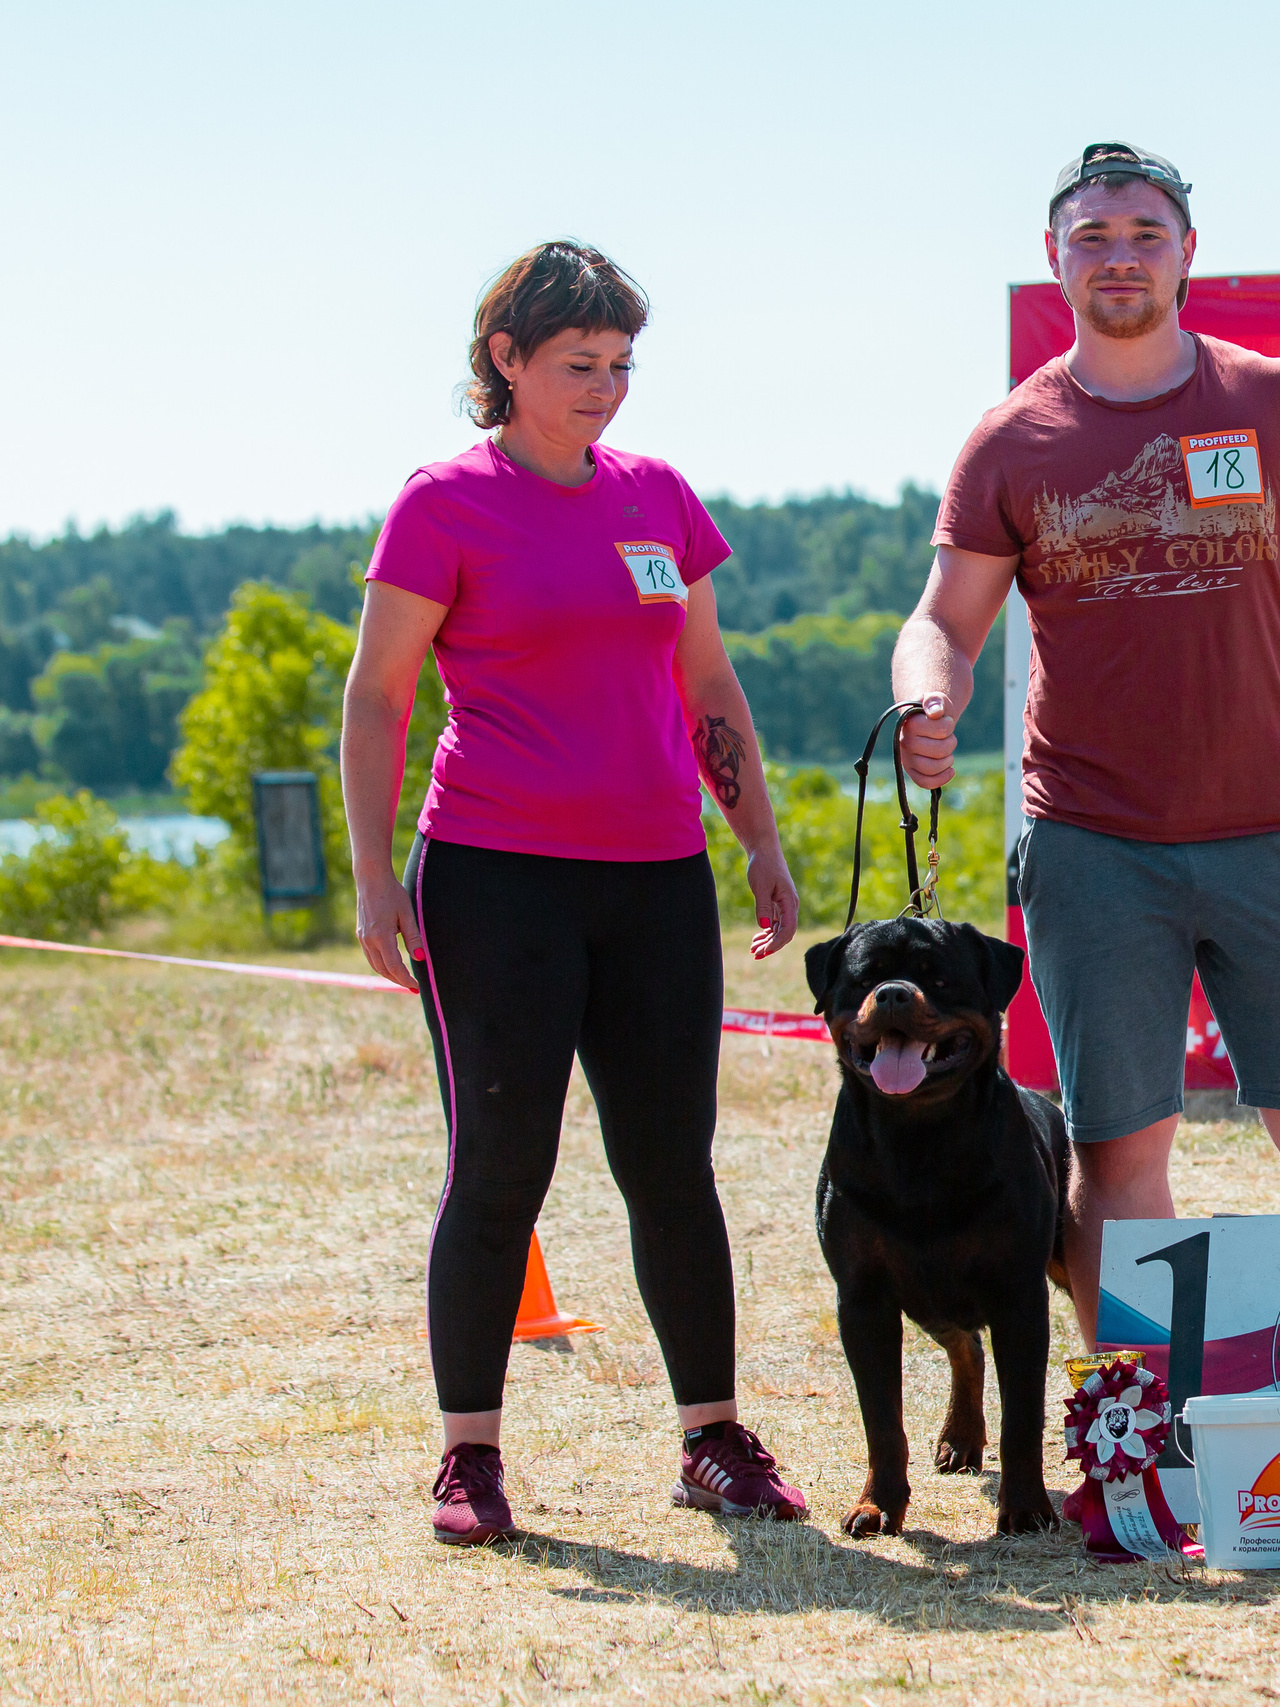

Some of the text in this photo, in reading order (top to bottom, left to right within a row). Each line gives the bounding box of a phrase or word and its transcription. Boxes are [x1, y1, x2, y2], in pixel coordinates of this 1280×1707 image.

[1189, 434, 1249, 450] PROFIFEED
[1206, 449, 1244, 489] 18
[646, 559, 676, 590] 18
[1135, 1231, 1210, 1468] 1
